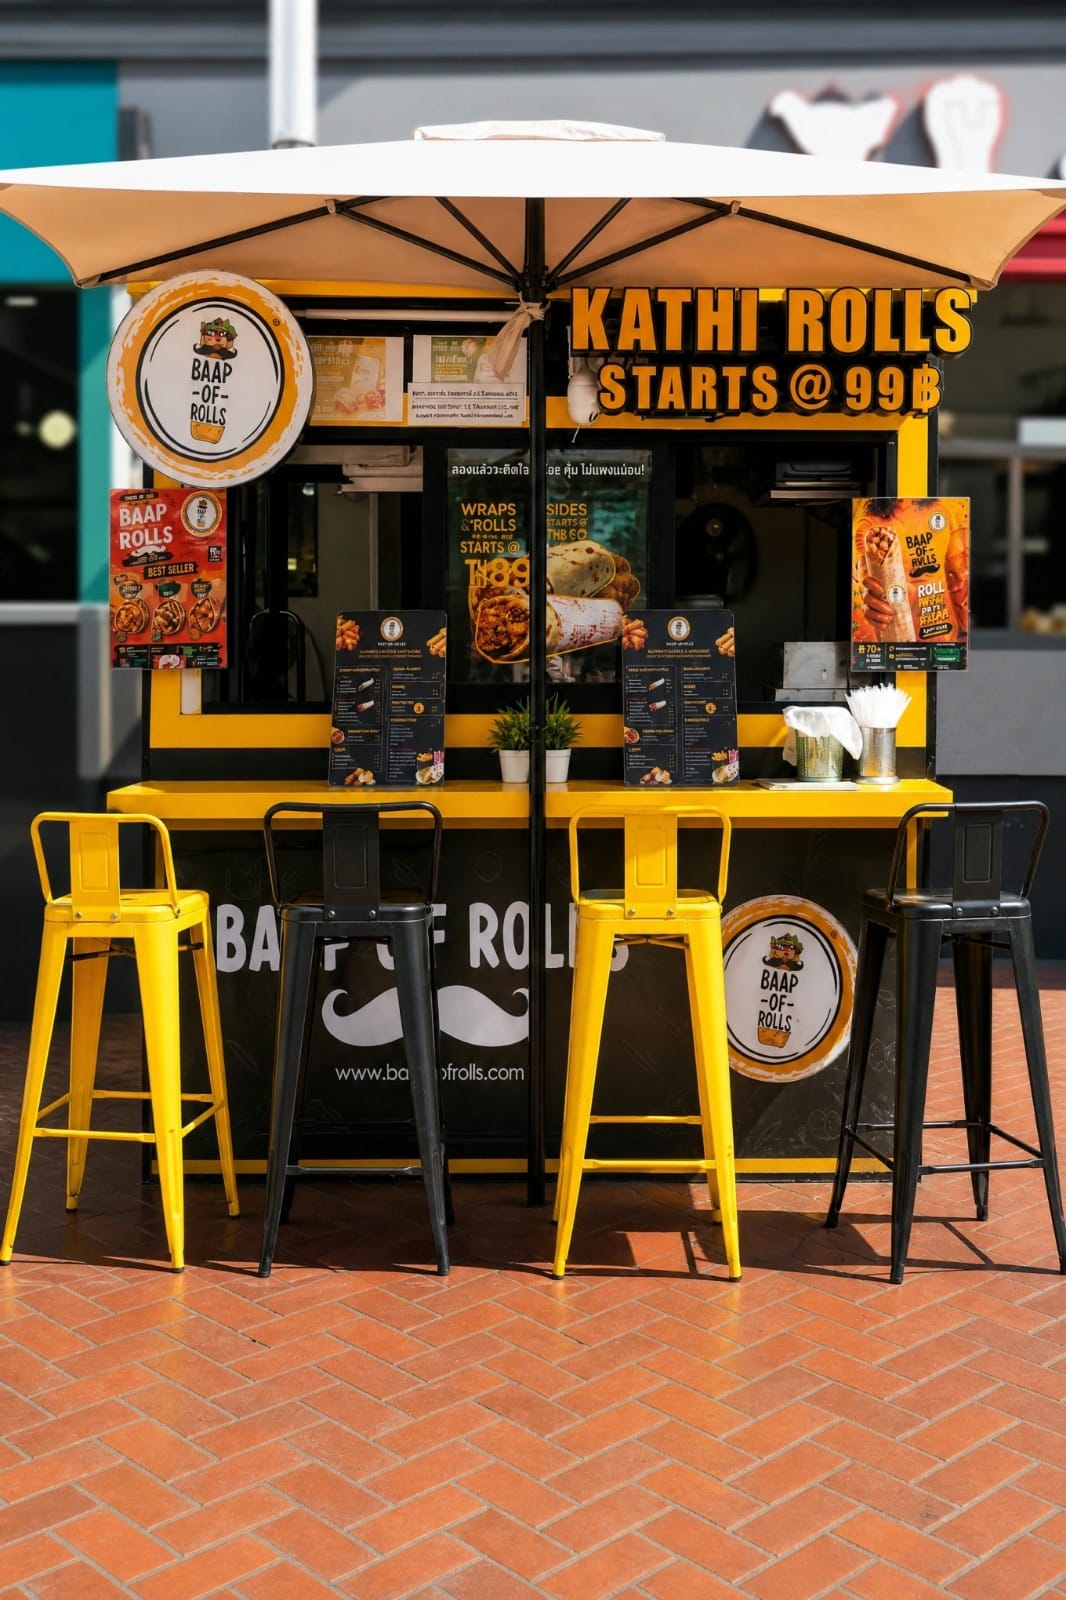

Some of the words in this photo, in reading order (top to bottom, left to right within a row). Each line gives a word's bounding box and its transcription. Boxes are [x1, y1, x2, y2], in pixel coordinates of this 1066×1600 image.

[571, 286, 758, 353] KATHI
[786, 286, 972, 356] ROLLS
[192, 358, 232, 384] BAAP
[598, 363, 778, 411] STARTS
[790, 363, 831, 411] @
[190, 403, 227, 426] ROLLS
[119, 504, 168, 527] BAAP
[460, 503, 516, 516] WRAPS
[546, 503, 587, 516] SIDES
[473, 519, 516, 532] ROLLS
[119, 526, 173, 550] ROLLS
[460, 540, 505, 554] STARTS
[906, 532, 933, 549] BAAP
[148, 566, 166, 577] BEST
[168, 563, 194, 575] SELLER
[918, 581, 944, 598] ROLL
[760, 969, 799, 994] BAAP
[758, 1010, 792, 1032] ROLLS
